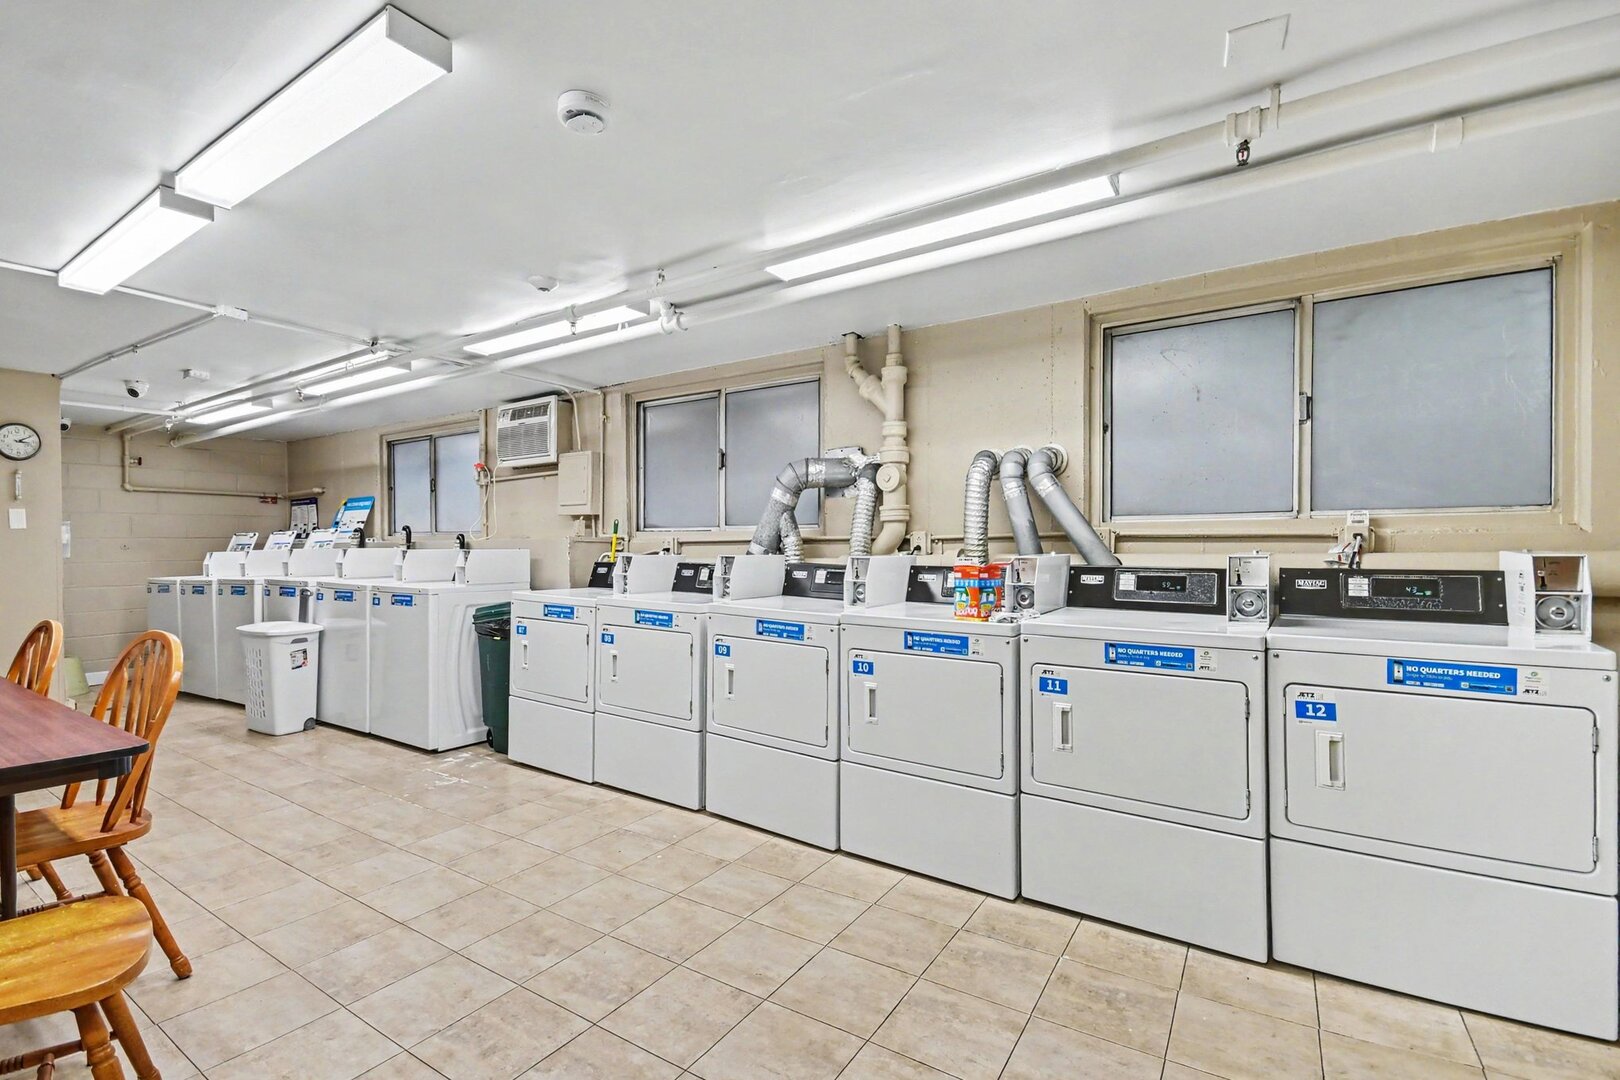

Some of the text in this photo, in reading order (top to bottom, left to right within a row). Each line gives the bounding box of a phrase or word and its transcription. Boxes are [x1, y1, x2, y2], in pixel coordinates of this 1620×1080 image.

[718, 645, 727, 654] 09
[857, 662, 869, 672] 10
[1406, 665, 1419, 673] NO
[1420, 667, 1465, 677] QUARTERS
[1466, 670, 1501, 679] NEEDED
[1046, 679, 1062, 691] 11
[1305, 703, 1327, 717] 12
